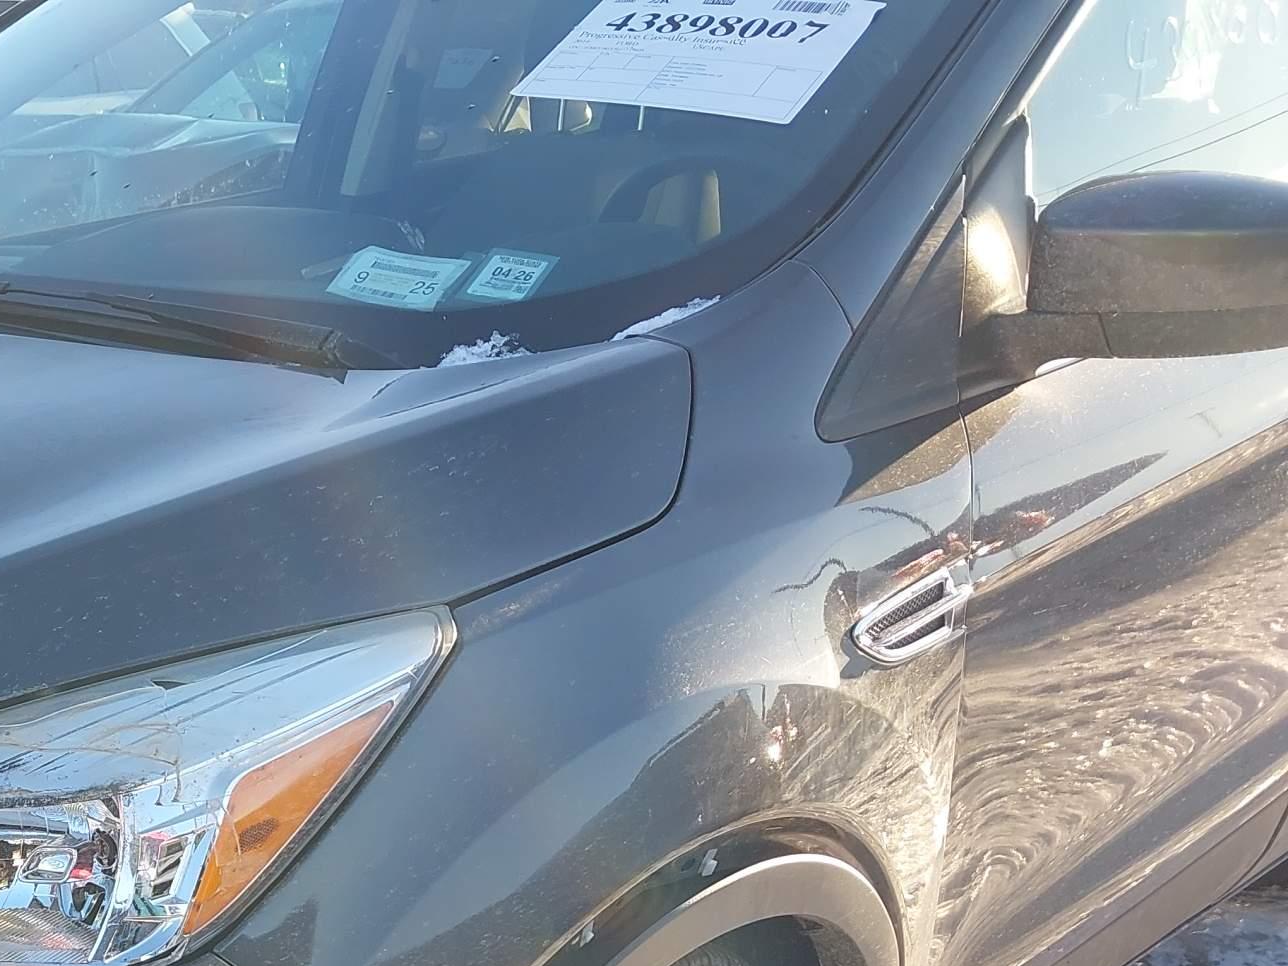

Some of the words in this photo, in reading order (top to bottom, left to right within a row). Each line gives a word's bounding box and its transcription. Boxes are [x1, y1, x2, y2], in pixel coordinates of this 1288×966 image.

[606, 12, 830, 43] 43898007
[579, 31, 640, 40] Progressive
[354, 271, 369, 283] 9
[492, 266, 512, 278] 04
[513, 270, 535, 281] 26
[409, 281, 438, 295] 25
